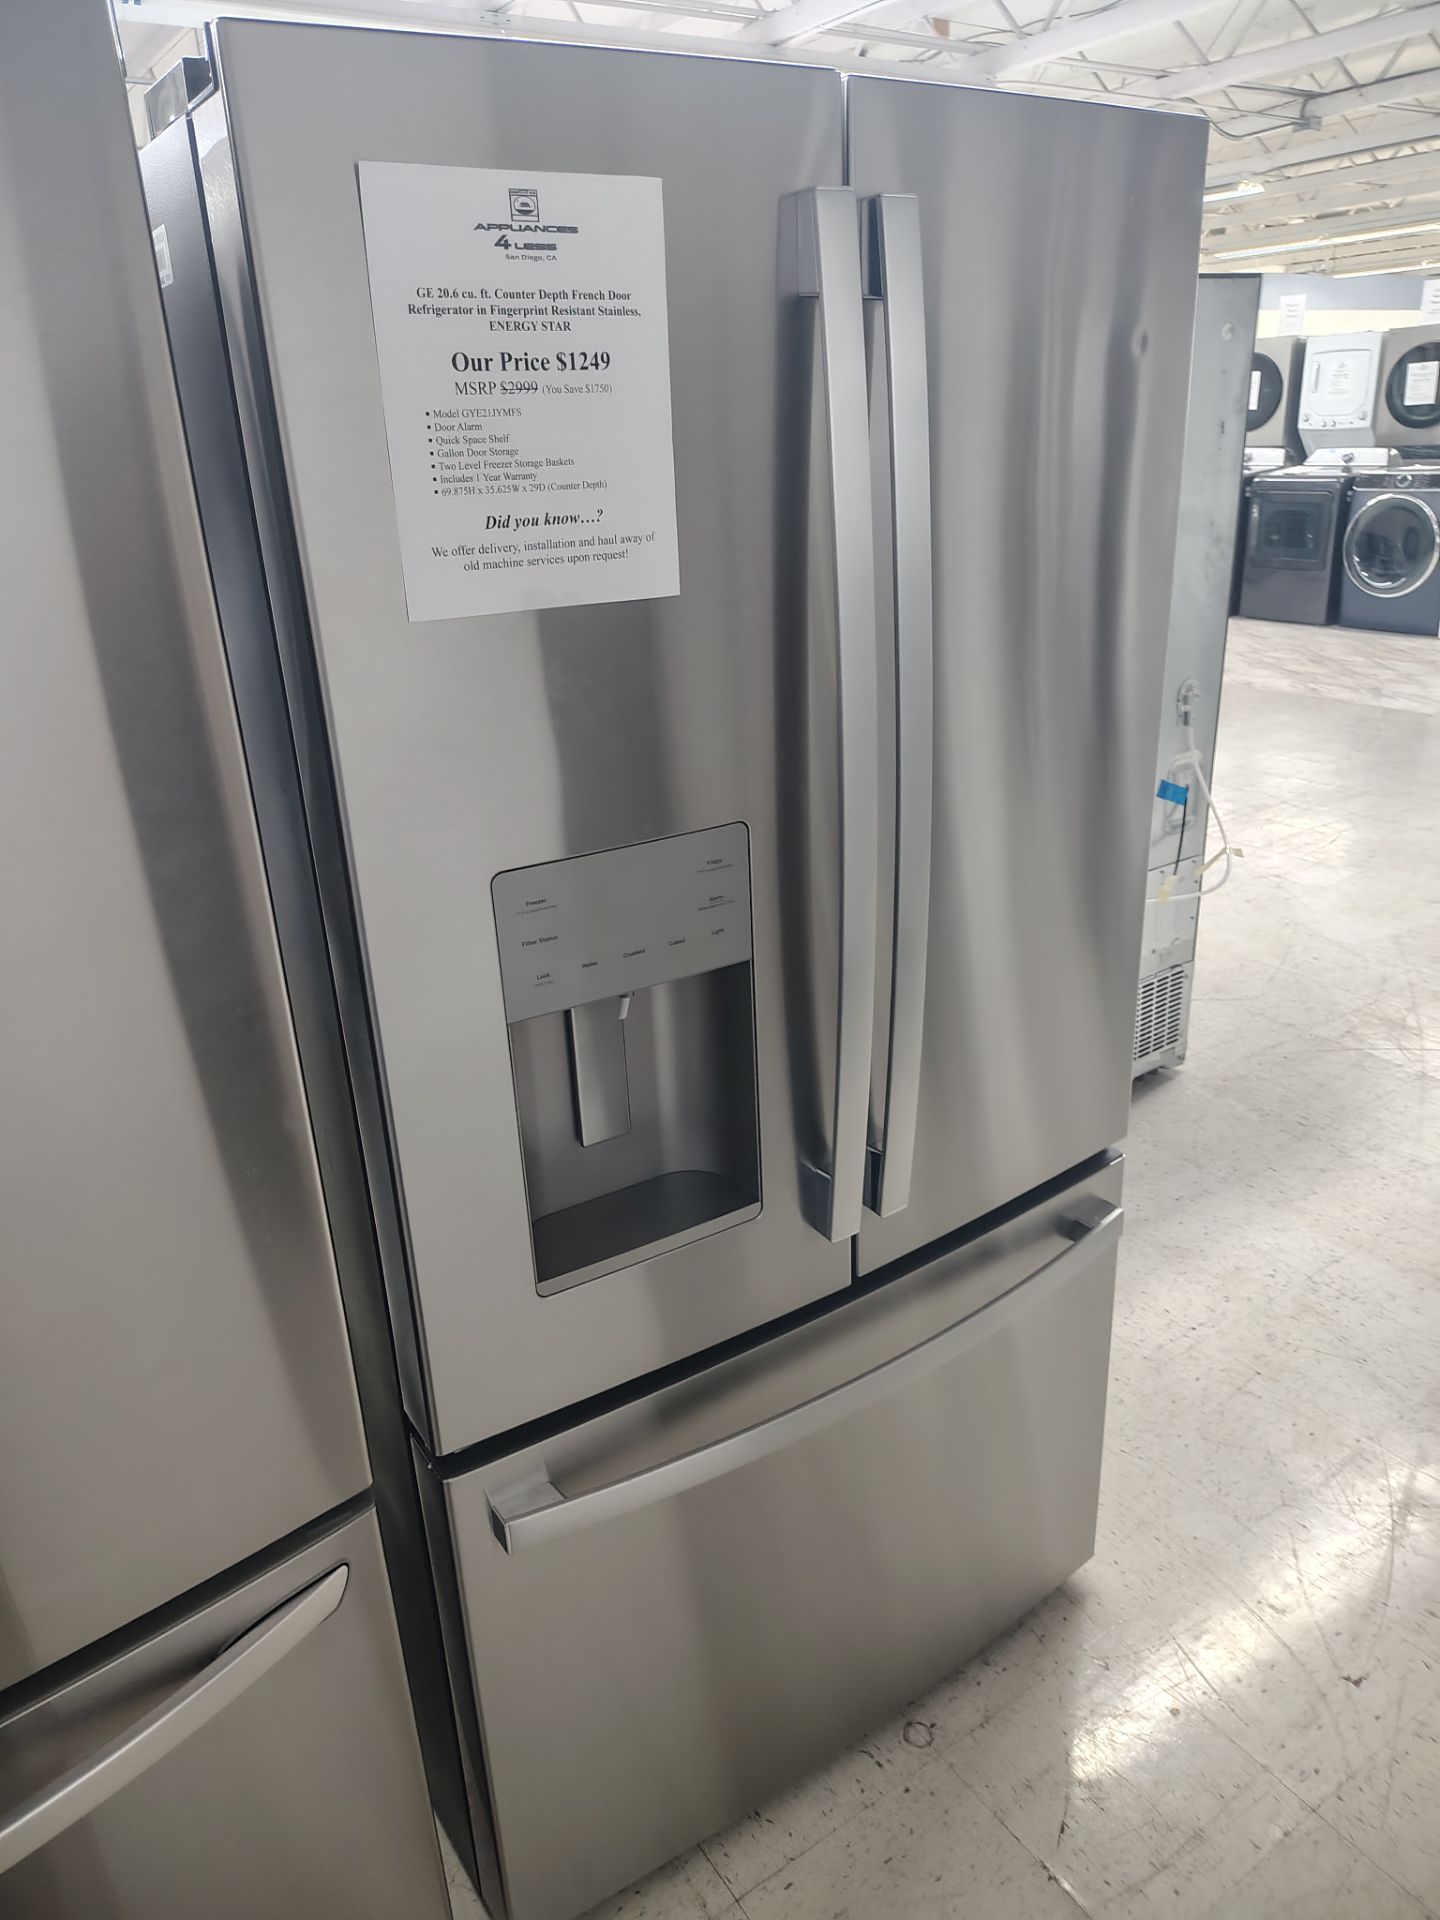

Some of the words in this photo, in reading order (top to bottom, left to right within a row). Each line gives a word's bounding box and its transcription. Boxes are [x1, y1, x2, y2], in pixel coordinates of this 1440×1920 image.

[473, 222, 579, 234] APPLIANCES
[494, 234, 512, 250] 4
[514, 242, 557, 251] LESS
[521, 254, 545, 262] Diego,
[416, 287, 434, 298] GE
[437, 287, 459, 299] 20.6
[461, 290, 477, 299] cu.
[480, 288, 491, 299] ft.
[494, 288, 536, 300] Counter
[539, 289, 569, 302] Depth
[572, 289, 605, 300] French
[608, 290, 632, 300] Door
[408, 303, 474, 318] Refrigerator
[476, 304, 487, 315] in
[490, 304, 548, 318] Fingerprint
[551, 305, 596, 316] Resistant
[597, 305, 642, 317] Stainless,
[489, 321, 538, 332] ENERGY
[541, 321, 571, 332] STAR
[451, 351, 494, 372] Our
[499, 351, 551, 372] Price
[556, 351, 611, 372] $1249
[454, 381, 497, 396] MSRP
[500, 380, 538, 395] $2999
[542, 384, 562, 396] (You
[563, 384, 583, 394] Save
[585, 383, 612, 394] $1750)
[433, 409, 460, 419] Model
[434, 422, 456, 432] Door
[457, 422, 483, 431] Alarm
[435, 435, 460, 446] Quick
[462, 435, 487, 446] Space
[488, 434, 511, 444] Shelf
[437, 448, 465, 458] Gallon
[467, 448, 488, 457] Door
[489, 447, 519, 457] Storage
[438, 462, 457, 471] Two
[458, 461, 481, 471] Level
[483, 460, 513, 470] Freezer
[514, 459, 544, 469] Storage
[545, 457, 575, 467] Baskets
[440, 474, 474, 484] Includes
[476, 473, 480, 482] 1
[482, 473, 502, 482] Year
[502, 472, 538, 481] Warranty
[441, 486, 475, 496] 69.875H
[485, 484, 520, 495] 35.625W
[529, 483, 546, 492] 29D
[547, 482, 581, 493] (Counter
[582, 480, 608, 491] Depth)
[485, 514, 511, 530] Did
[513, 516, 540, 532] you
[431, 546, 449, 557] We
[451, 545, 476, 557] offer
[478, 543, 521, 555] delivery,
[523, 538, 576, 552] installation
[578, 536, 595, 547] and
[597, 534, 618, 546] haul
[619, 535, 643, 545] away
[645, 531, 656, 542] of
[463, 560, 480, 572] old
[482, 557, 524, 570] machine
[526, 554, 565, 567] services
[567, 554, 591, 566] upon
[592, 548, 629, 563] request!
[525, 898, 547, 907] Freezer
[521, 940, 538, 948] Filter
[538, 935, 558, 944] Status
